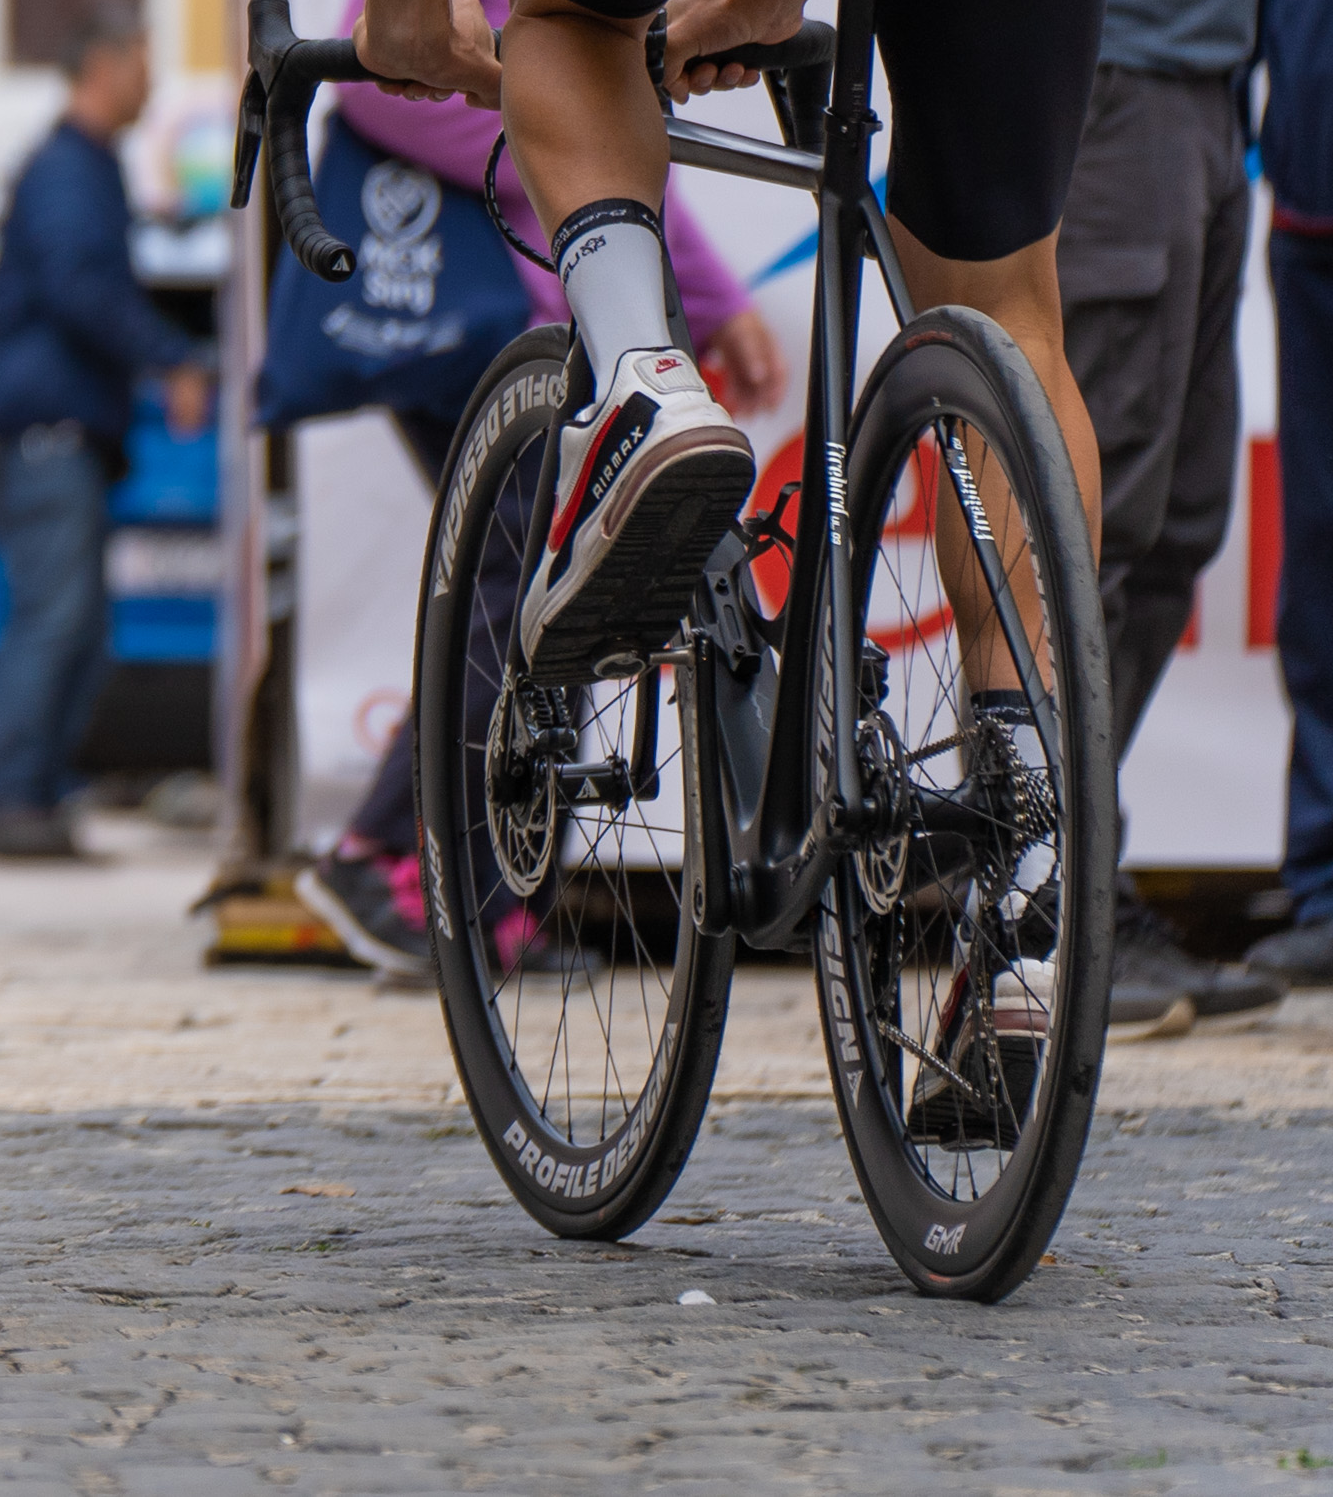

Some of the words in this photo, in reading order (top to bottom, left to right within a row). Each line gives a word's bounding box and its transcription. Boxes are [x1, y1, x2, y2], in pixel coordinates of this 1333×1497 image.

[819, 874, 861, 1063] ESIGN
[502, 1116, 602, 1199] PROFILE
[600, 1042, 673, 1190] DESIGN
[924, 1221, 968, 1256] GMR
